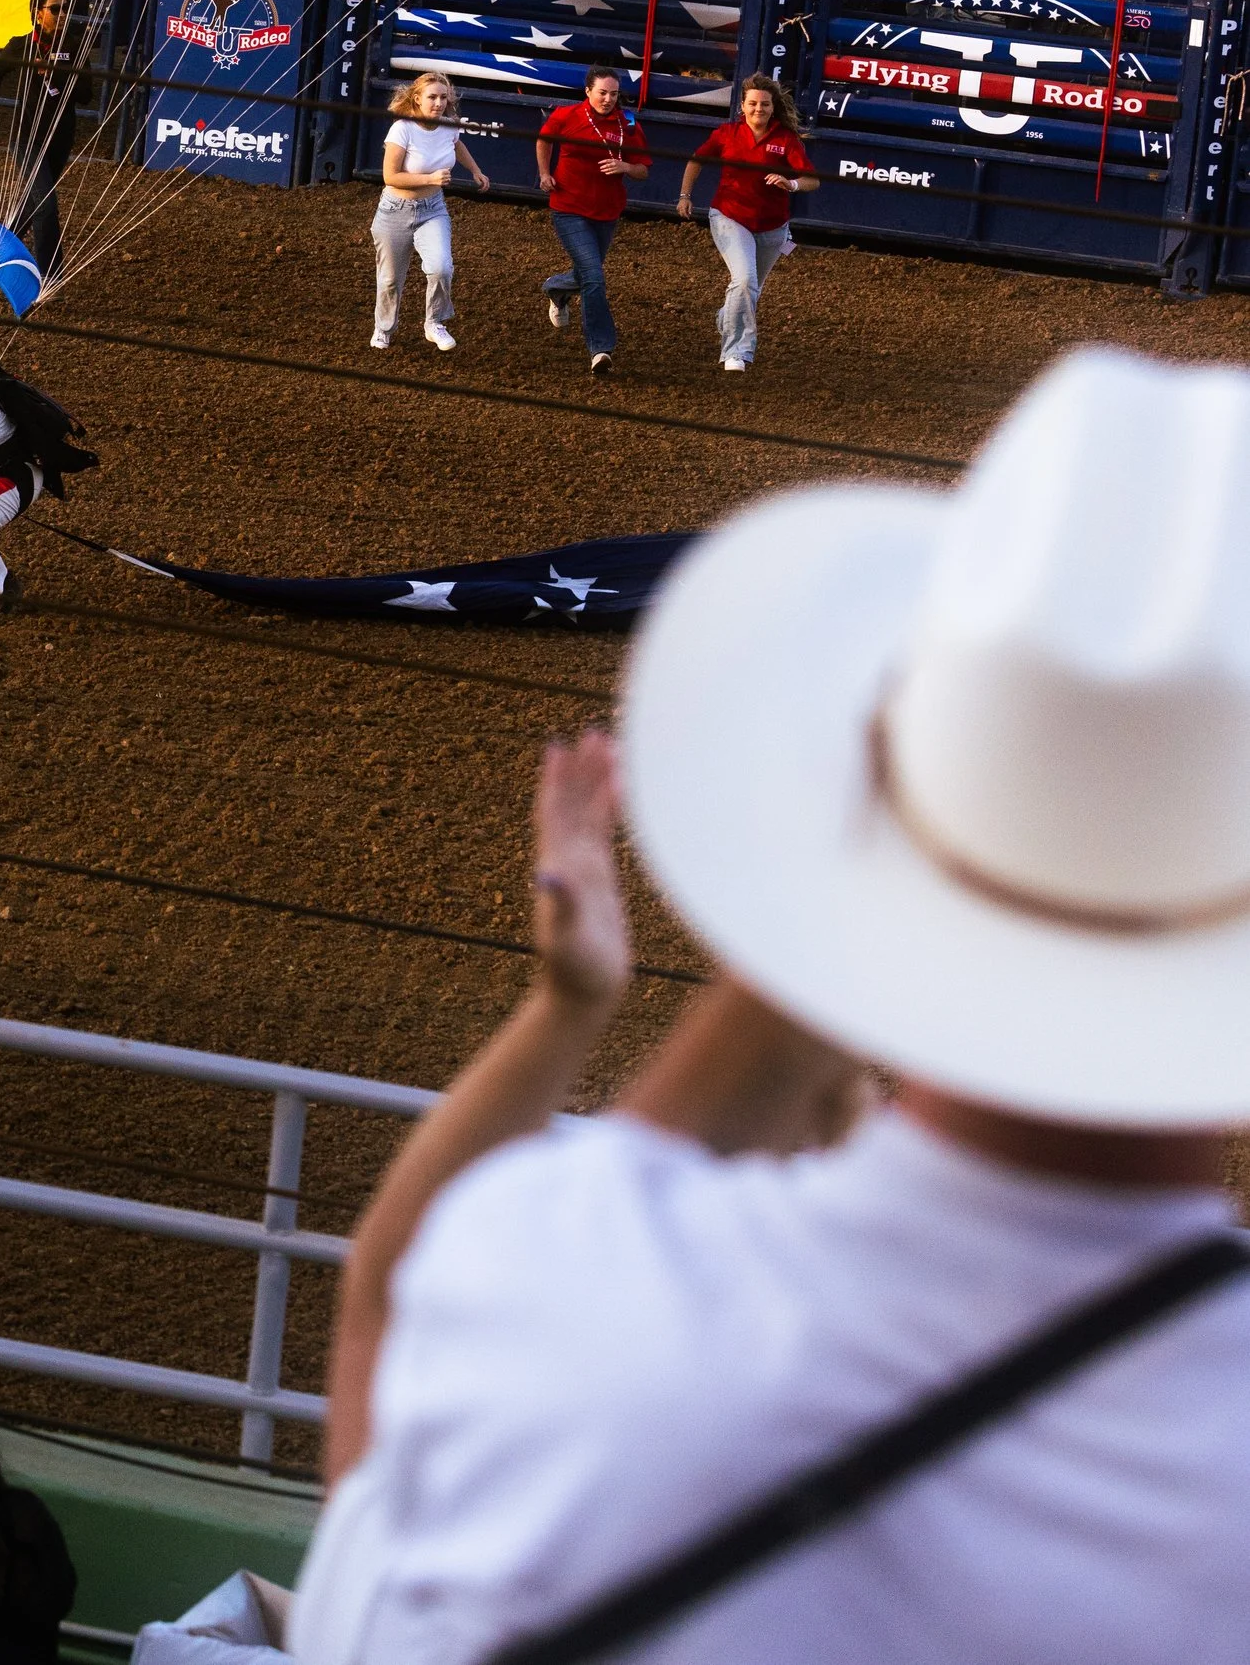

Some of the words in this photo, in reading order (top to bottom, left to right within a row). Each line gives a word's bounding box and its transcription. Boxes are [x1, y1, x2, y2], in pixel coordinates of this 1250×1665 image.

[1125, 7, 1152, 16] AMERICA
[1124, 15, 1152, 29] 250
[168, 19, 216, 48] Flying
[240, 31, 288, 50] Rodeo
[849, 60, 951, 94] Flying
[1042, 84, 1144, 114] Rodeo
[931, 118, 955, 129] SINCE
[156, 118, 284, 155] Priefert
[1025, 130, 1044, 140] 1956
[179, 145, 208, 157] Farm,
[210, 148, 242, 159] Ranch
[838, 160, 932, 189] Priefert
